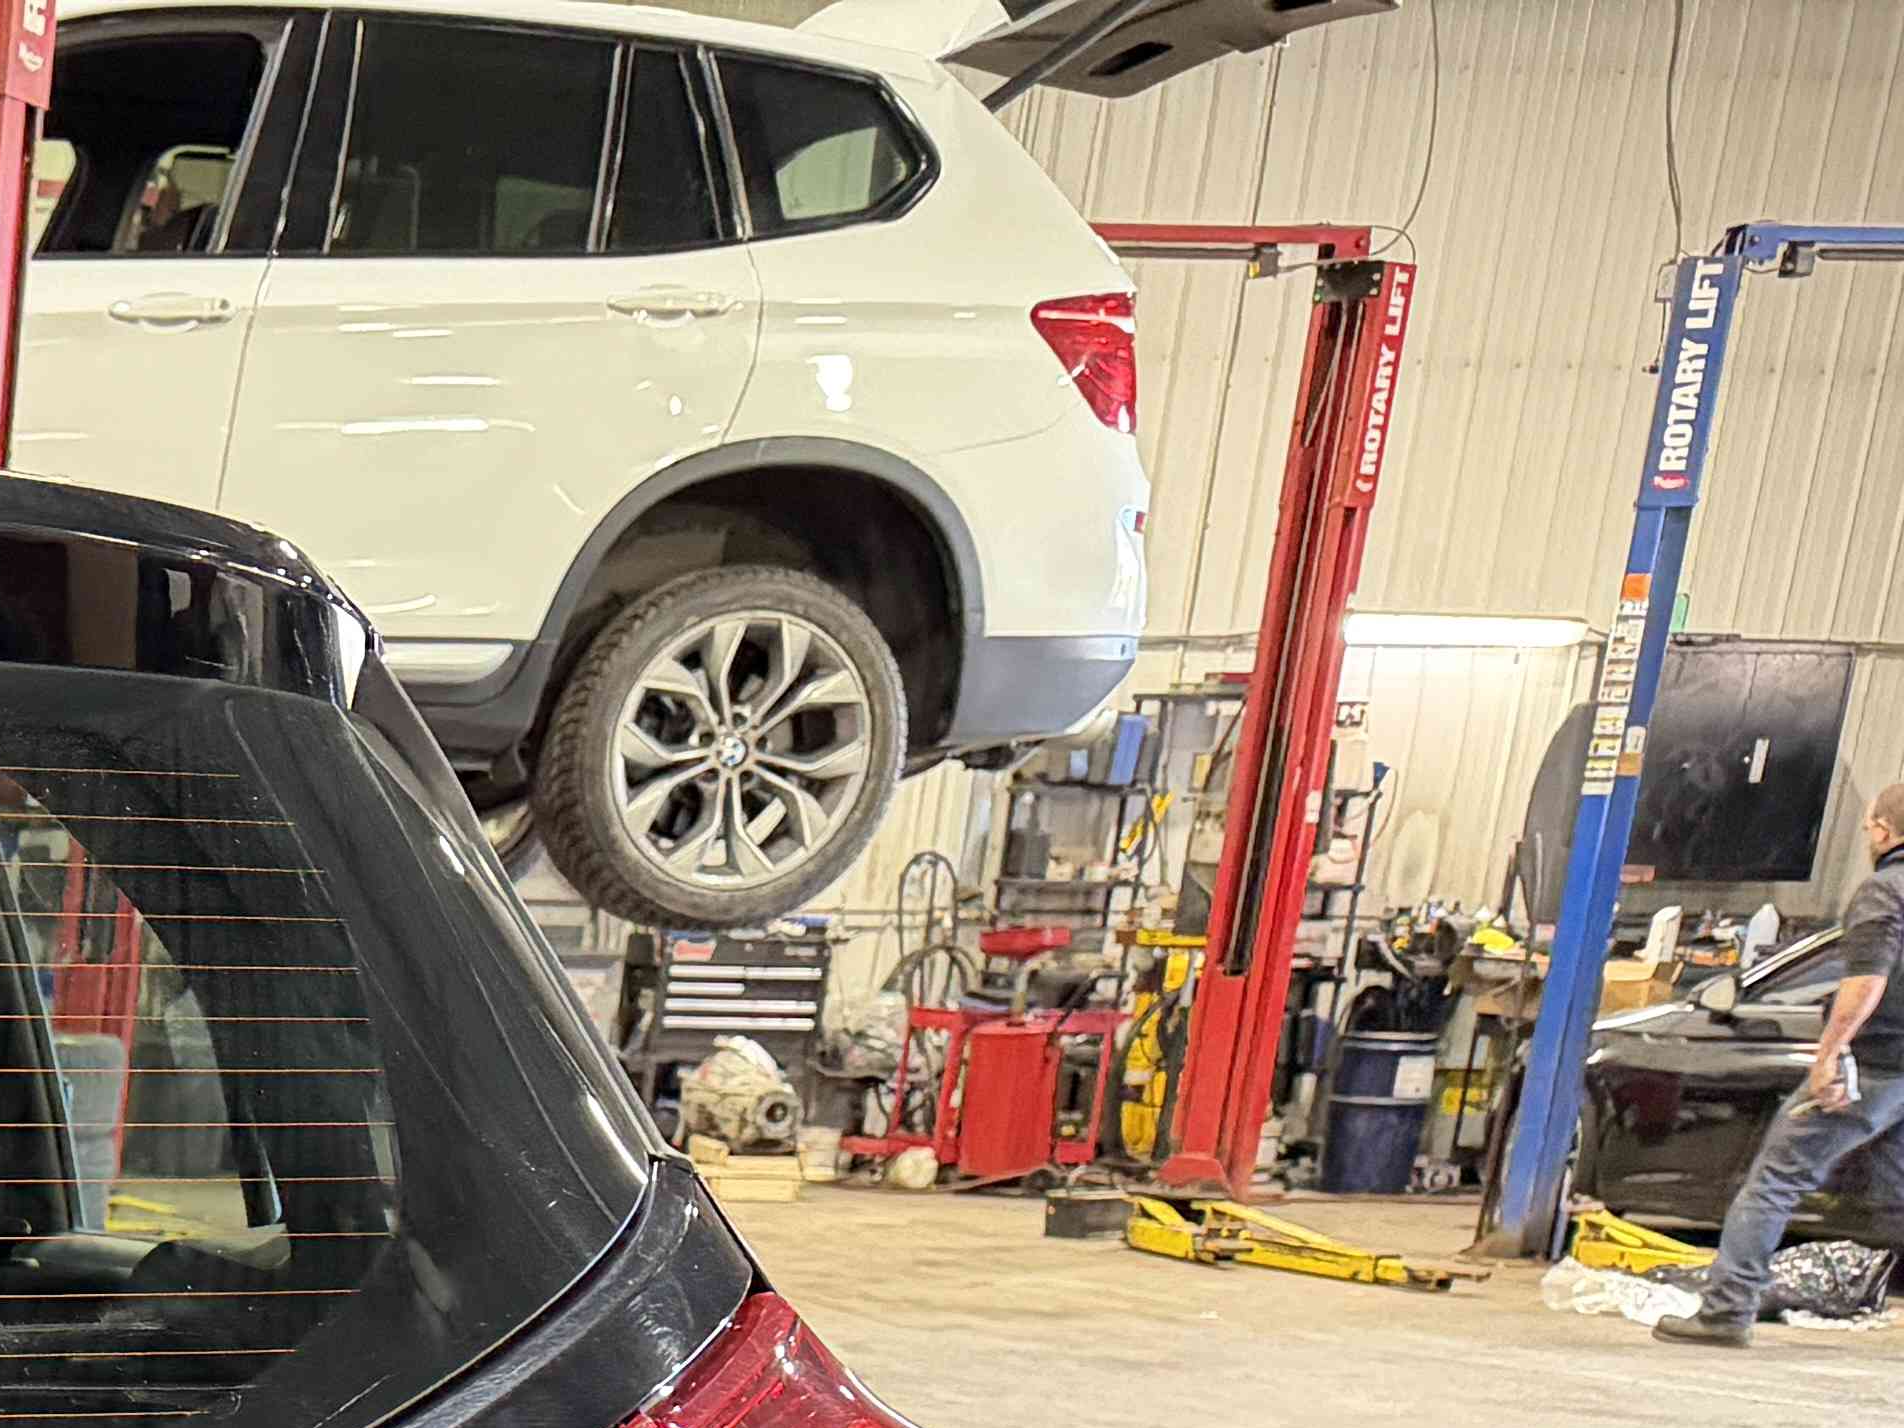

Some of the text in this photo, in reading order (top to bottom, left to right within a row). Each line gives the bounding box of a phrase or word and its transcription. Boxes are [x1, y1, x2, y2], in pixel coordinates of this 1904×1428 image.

[1359, 266, 1410, 476] ROTARY LIFT
[1658, 259, 1724, 471] ROTARY LIFT
